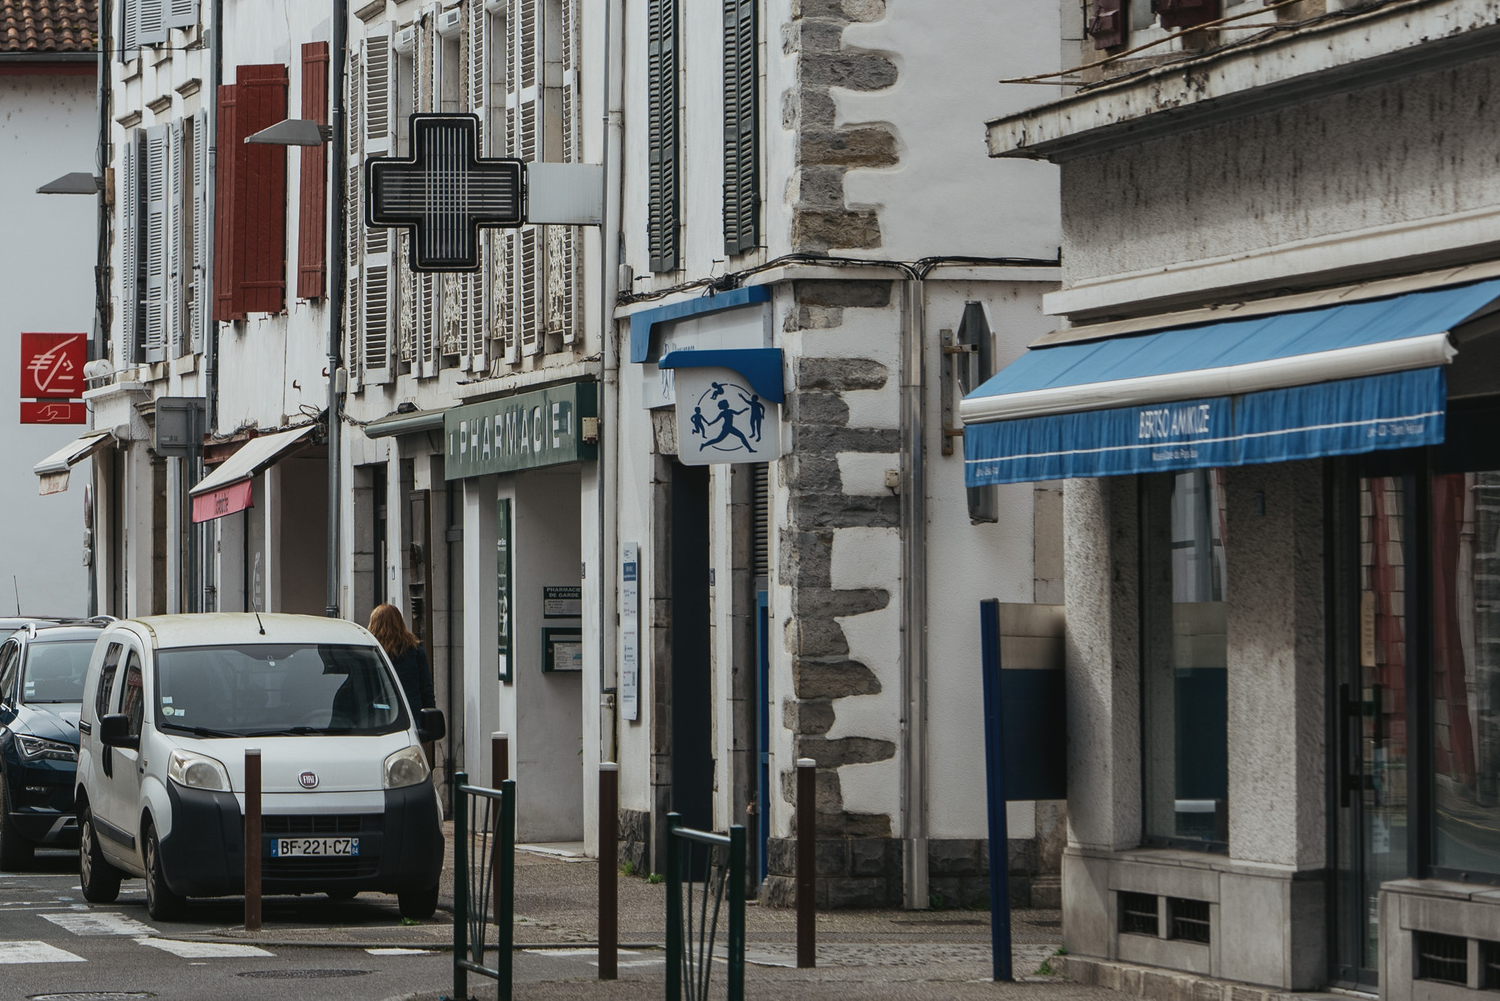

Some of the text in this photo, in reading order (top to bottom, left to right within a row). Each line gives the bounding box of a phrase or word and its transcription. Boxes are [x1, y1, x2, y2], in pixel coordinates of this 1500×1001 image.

[458, 401, 560, 465] PHARMACIE
[302, 775, 315, 784] FIAT
[280, 839, 351, 855] BF-221-CZ
